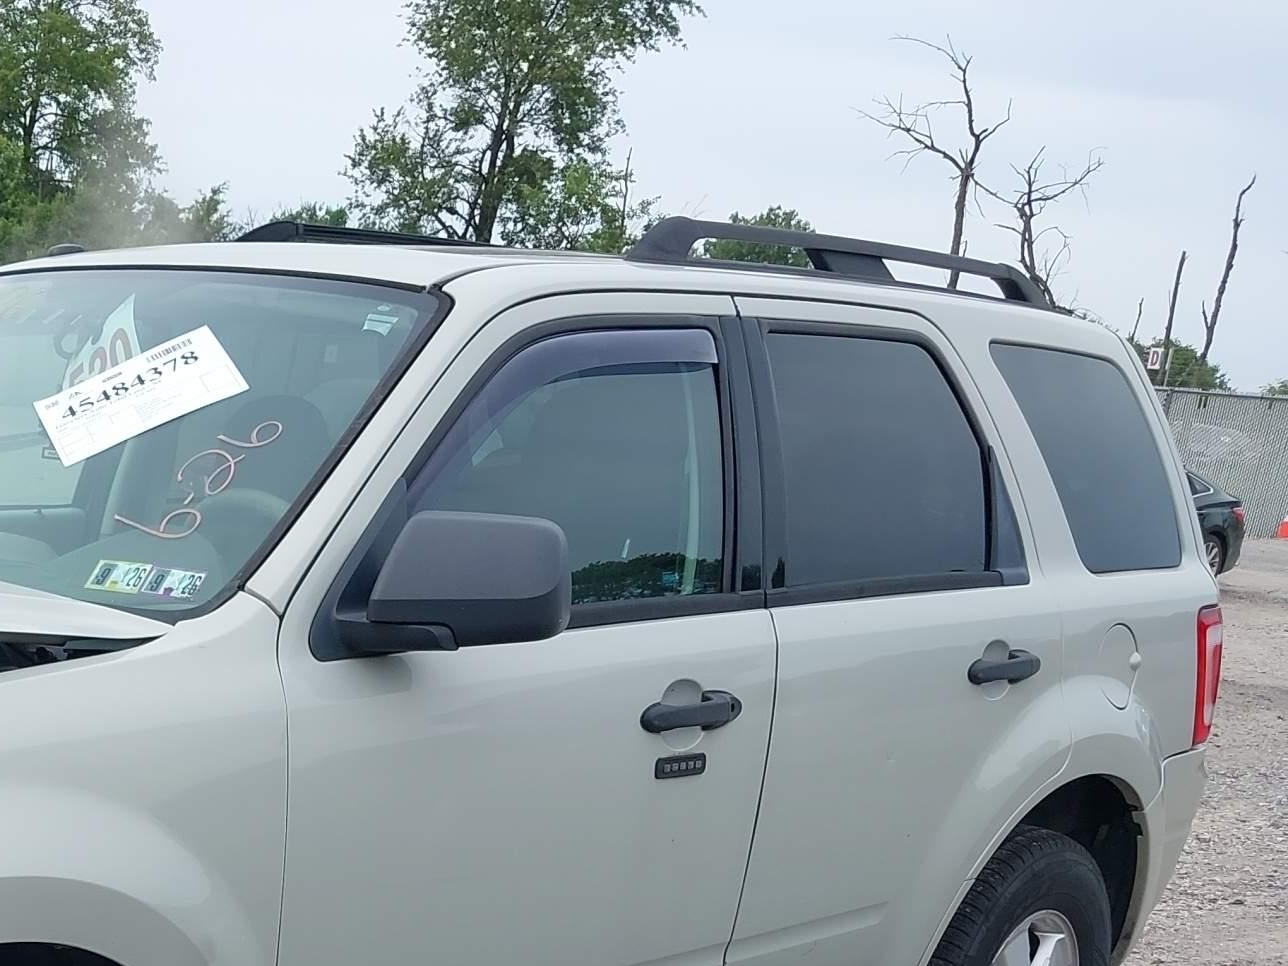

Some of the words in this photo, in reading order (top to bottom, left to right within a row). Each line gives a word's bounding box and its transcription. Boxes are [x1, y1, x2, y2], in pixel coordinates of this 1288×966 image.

[62, 350, 199, 420] 45484378
[1150, 350, 1159, 366] D
[114, 420, 283, 539] 6-26
